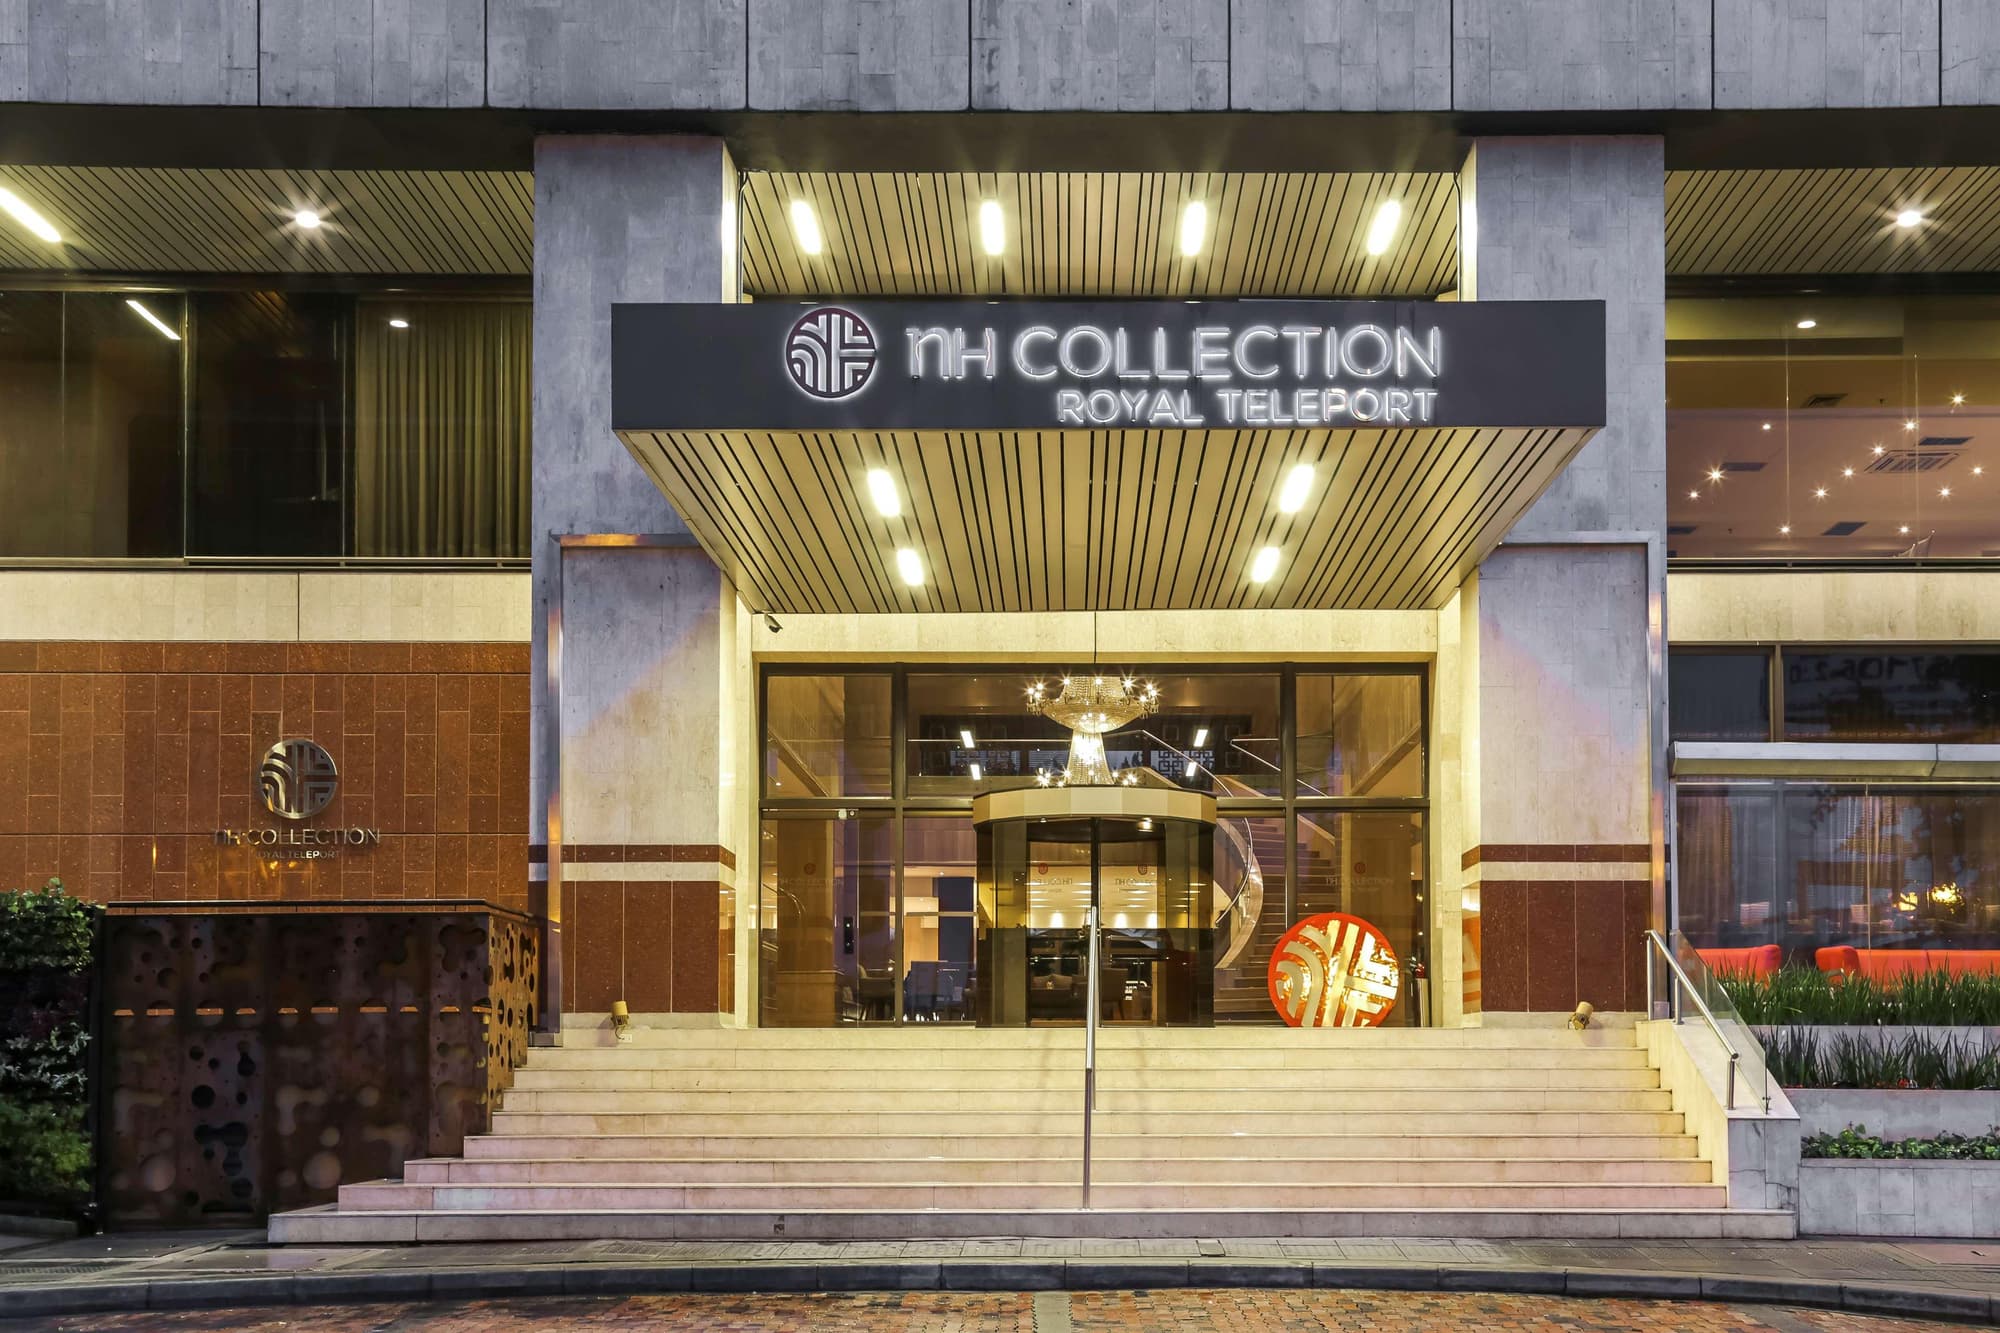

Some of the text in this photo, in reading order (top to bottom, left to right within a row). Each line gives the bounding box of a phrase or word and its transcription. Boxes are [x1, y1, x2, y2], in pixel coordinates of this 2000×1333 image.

[1012, 323, 1441, 379] COLLECTION
[1056, 387, 1439, 424] ROYAL TELEPORT
[246, 827, 380, 846] COLLECTION
